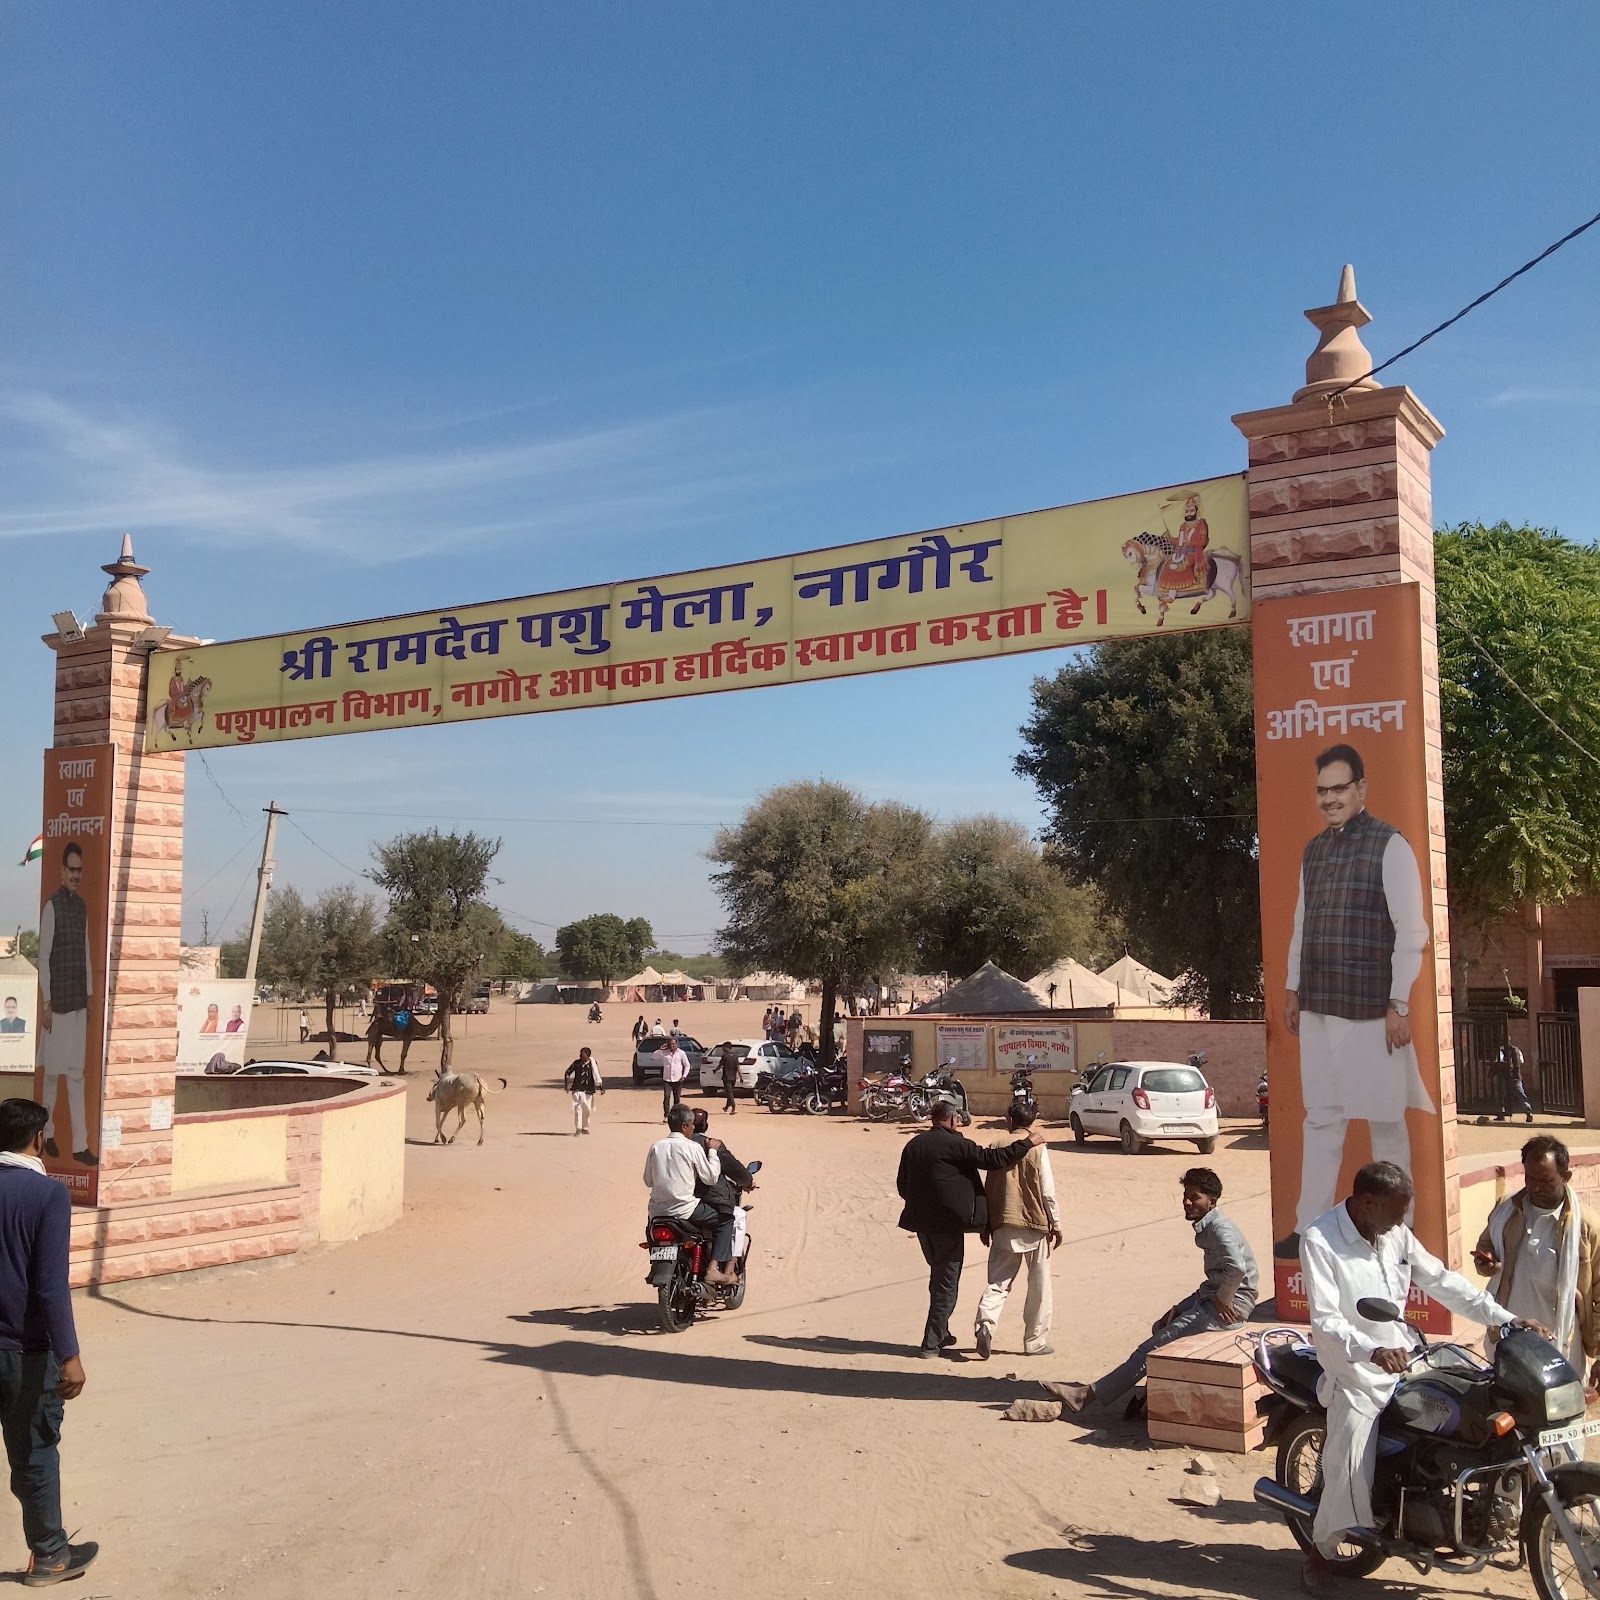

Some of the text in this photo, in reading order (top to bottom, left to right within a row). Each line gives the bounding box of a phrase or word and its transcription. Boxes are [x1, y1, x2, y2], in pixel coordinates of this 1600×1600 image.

[280, 535, 1002, 680] श्री रामदेव पशु मेला, नागौर
[1287, 610, 1376, 647] स्वागत
[215, 700, 337, 742] पशुपालन
[342, 688, 441, 721] विभाग,
[451, 669, 542, 707] नागौर
[550, 658, 667, 697] आपका
[673, 637, 787, 682] हार्दिक
[795, 622, 920, 666] स्वागत
[927, 603, 1046, 646] करता
[1310, 650, 1358, 690] एवं
[1267, 699, 1406, 740] अभिनन्दन
[58, 759, 96, 779] स्वागत
[67, 783, 87, 807] एवं
[47, 813, 105, 837] अभिनन्दन
[998, 1041, 1026, 1055] पशुपालन
